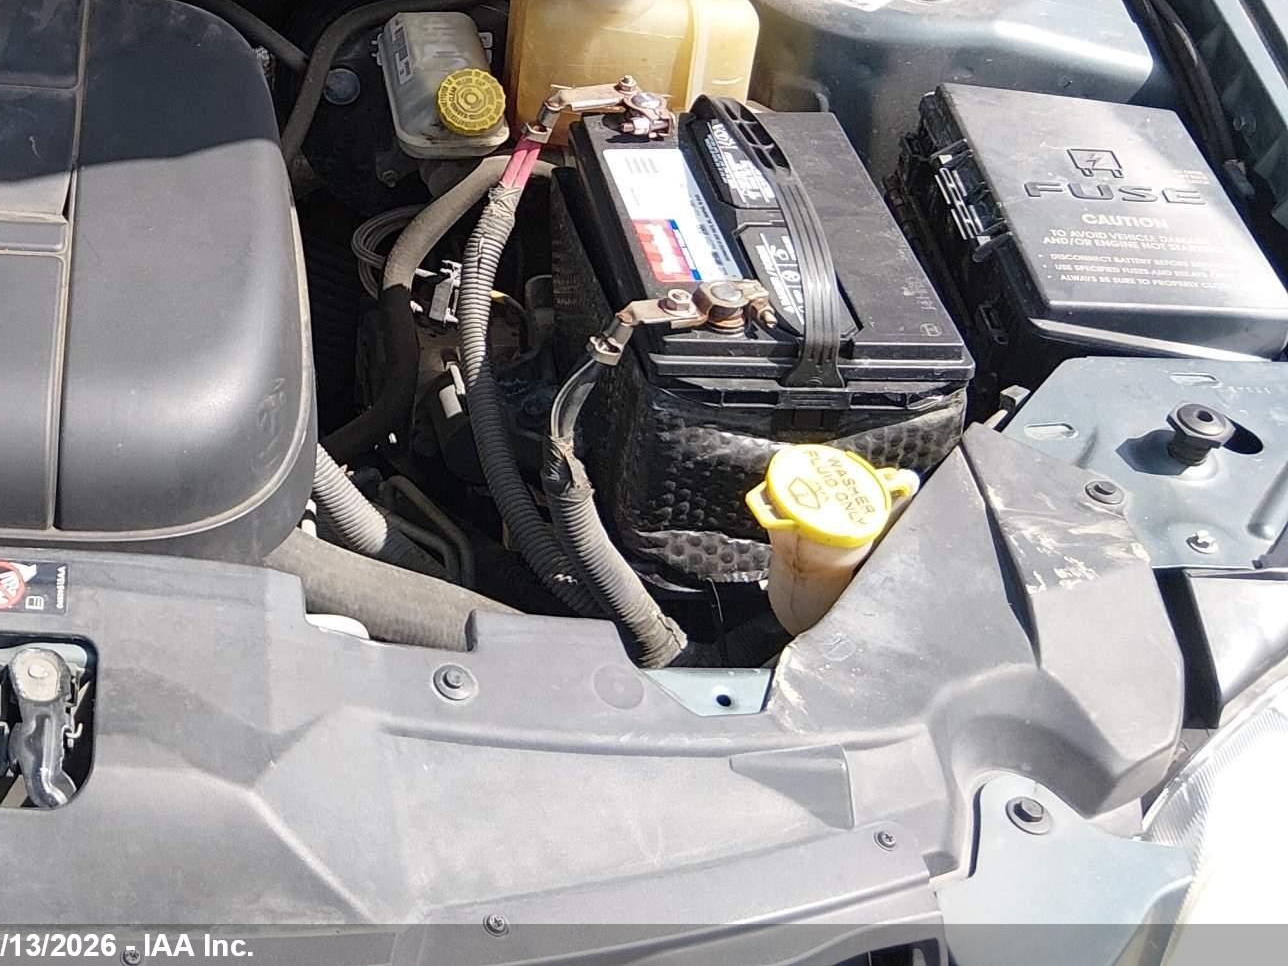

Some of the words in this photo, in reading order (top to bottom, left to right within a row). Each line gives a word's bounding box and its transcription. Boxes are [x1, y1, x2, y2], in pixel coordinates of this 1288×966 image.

[1024, 181, 1207, 205] FUSE
[1080, 213, 1169, 229] CAUTION
[1043, 237, 1093, 247] AND/OR
[1049, 229, 1067, 238] TO
[1070, 230, 1108, 240] AVOID
[1108, 233, 1157, 243] VEHICLE
[808, 450, 839, 488] FLUID
[834, 492, 868, 525] ONLY
[828, 457, 876, 514] WASHER
